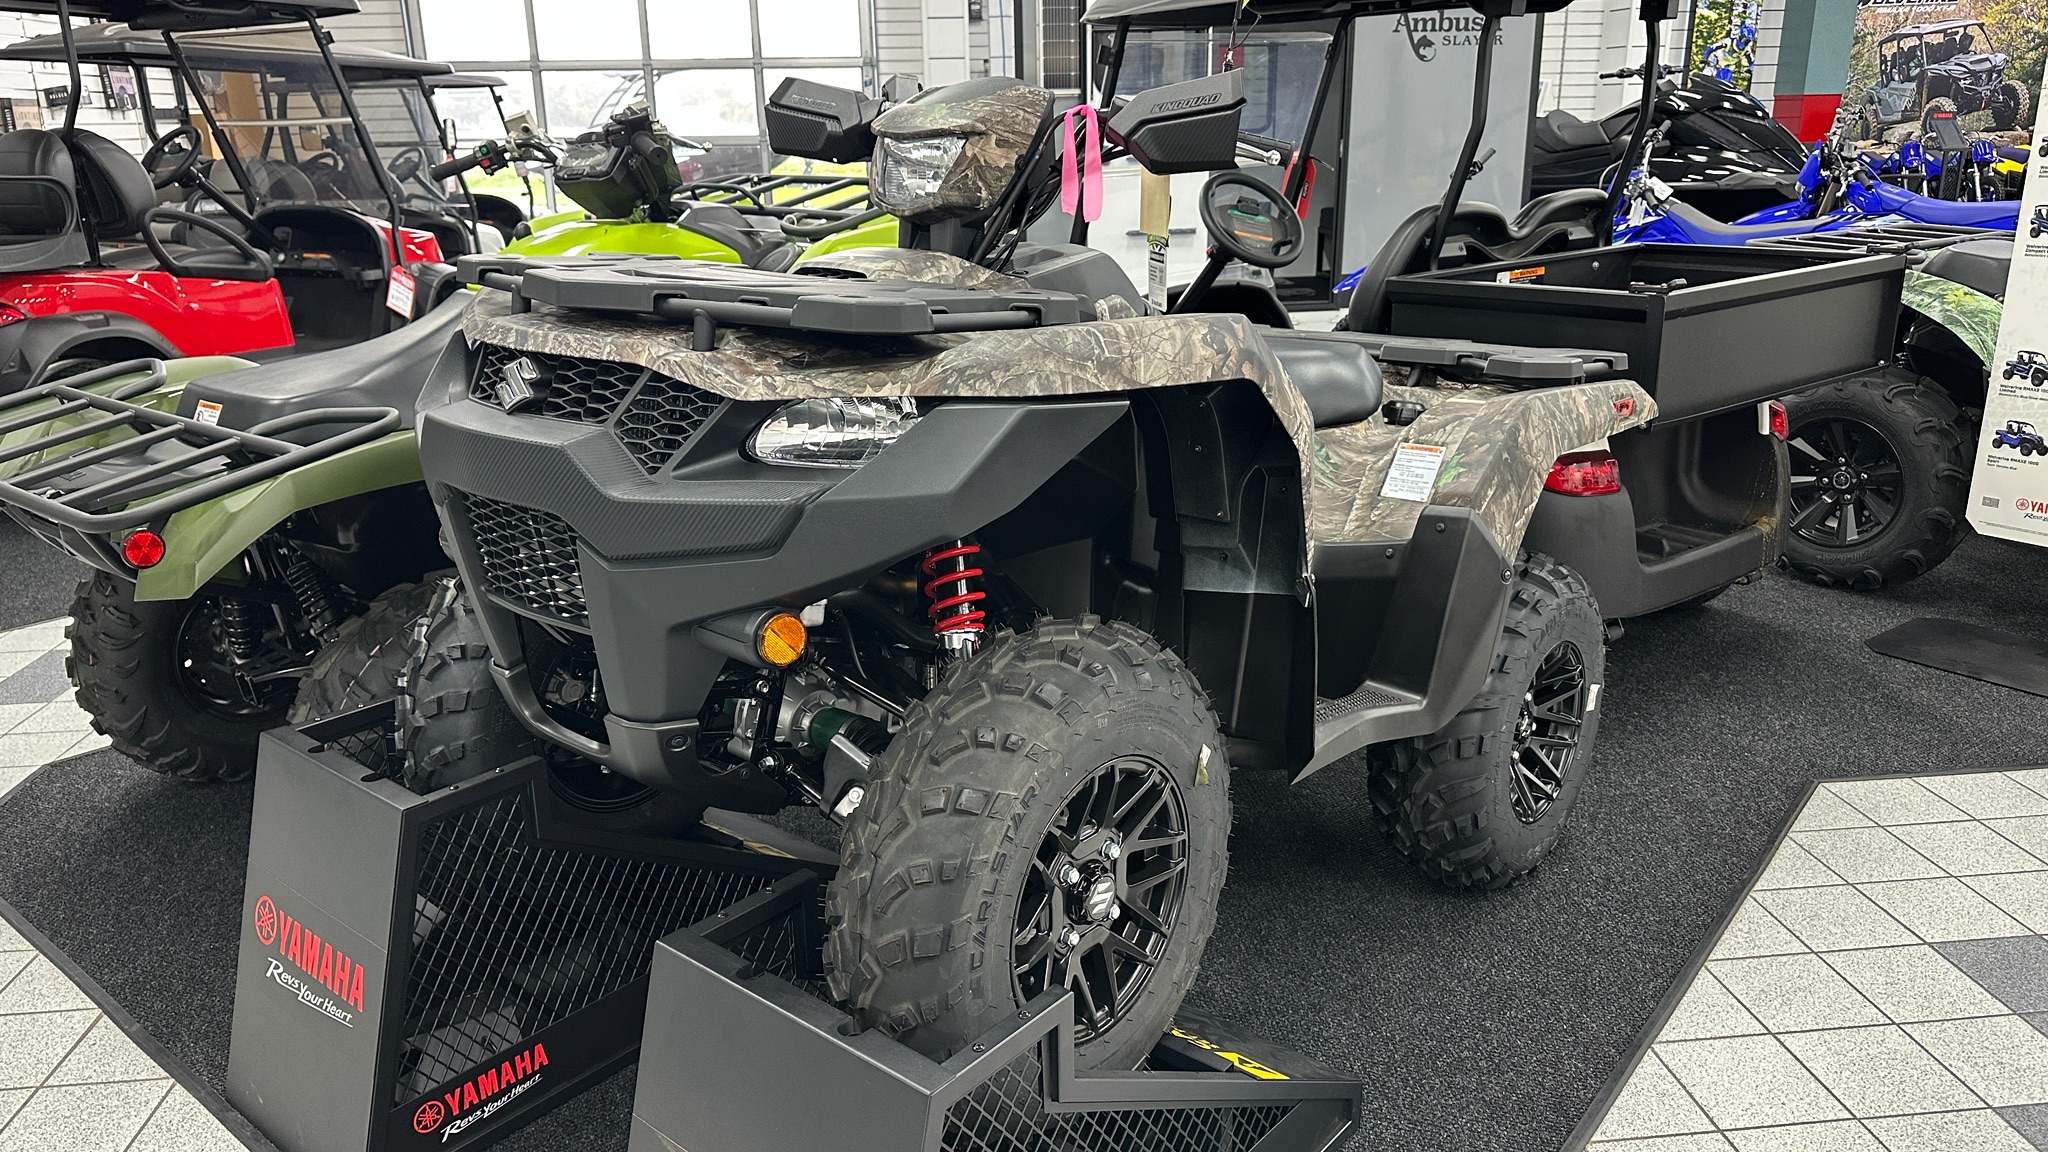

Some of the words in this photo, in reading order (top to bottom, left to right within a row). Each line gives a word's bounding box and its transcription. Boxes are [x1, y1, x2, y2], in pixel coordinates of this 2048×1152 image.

[1442, 35, 1503, 46] SLAYR
[1150, 93, 1222, 114] KINGQUAD
[265, 957, 300, 989] Revs
[298, 982, 324, 1006] Your
[322, 998, 353, 1023] Heart
[279, 909, 364, 1013] YAMAHA
[440, 1108, 483, 1143] Revs
[483, 1090, 510, 1118] Your
[511, 1073, 541, 1098] Heart
[444, 1043, 549, 1116] YAMAHA
